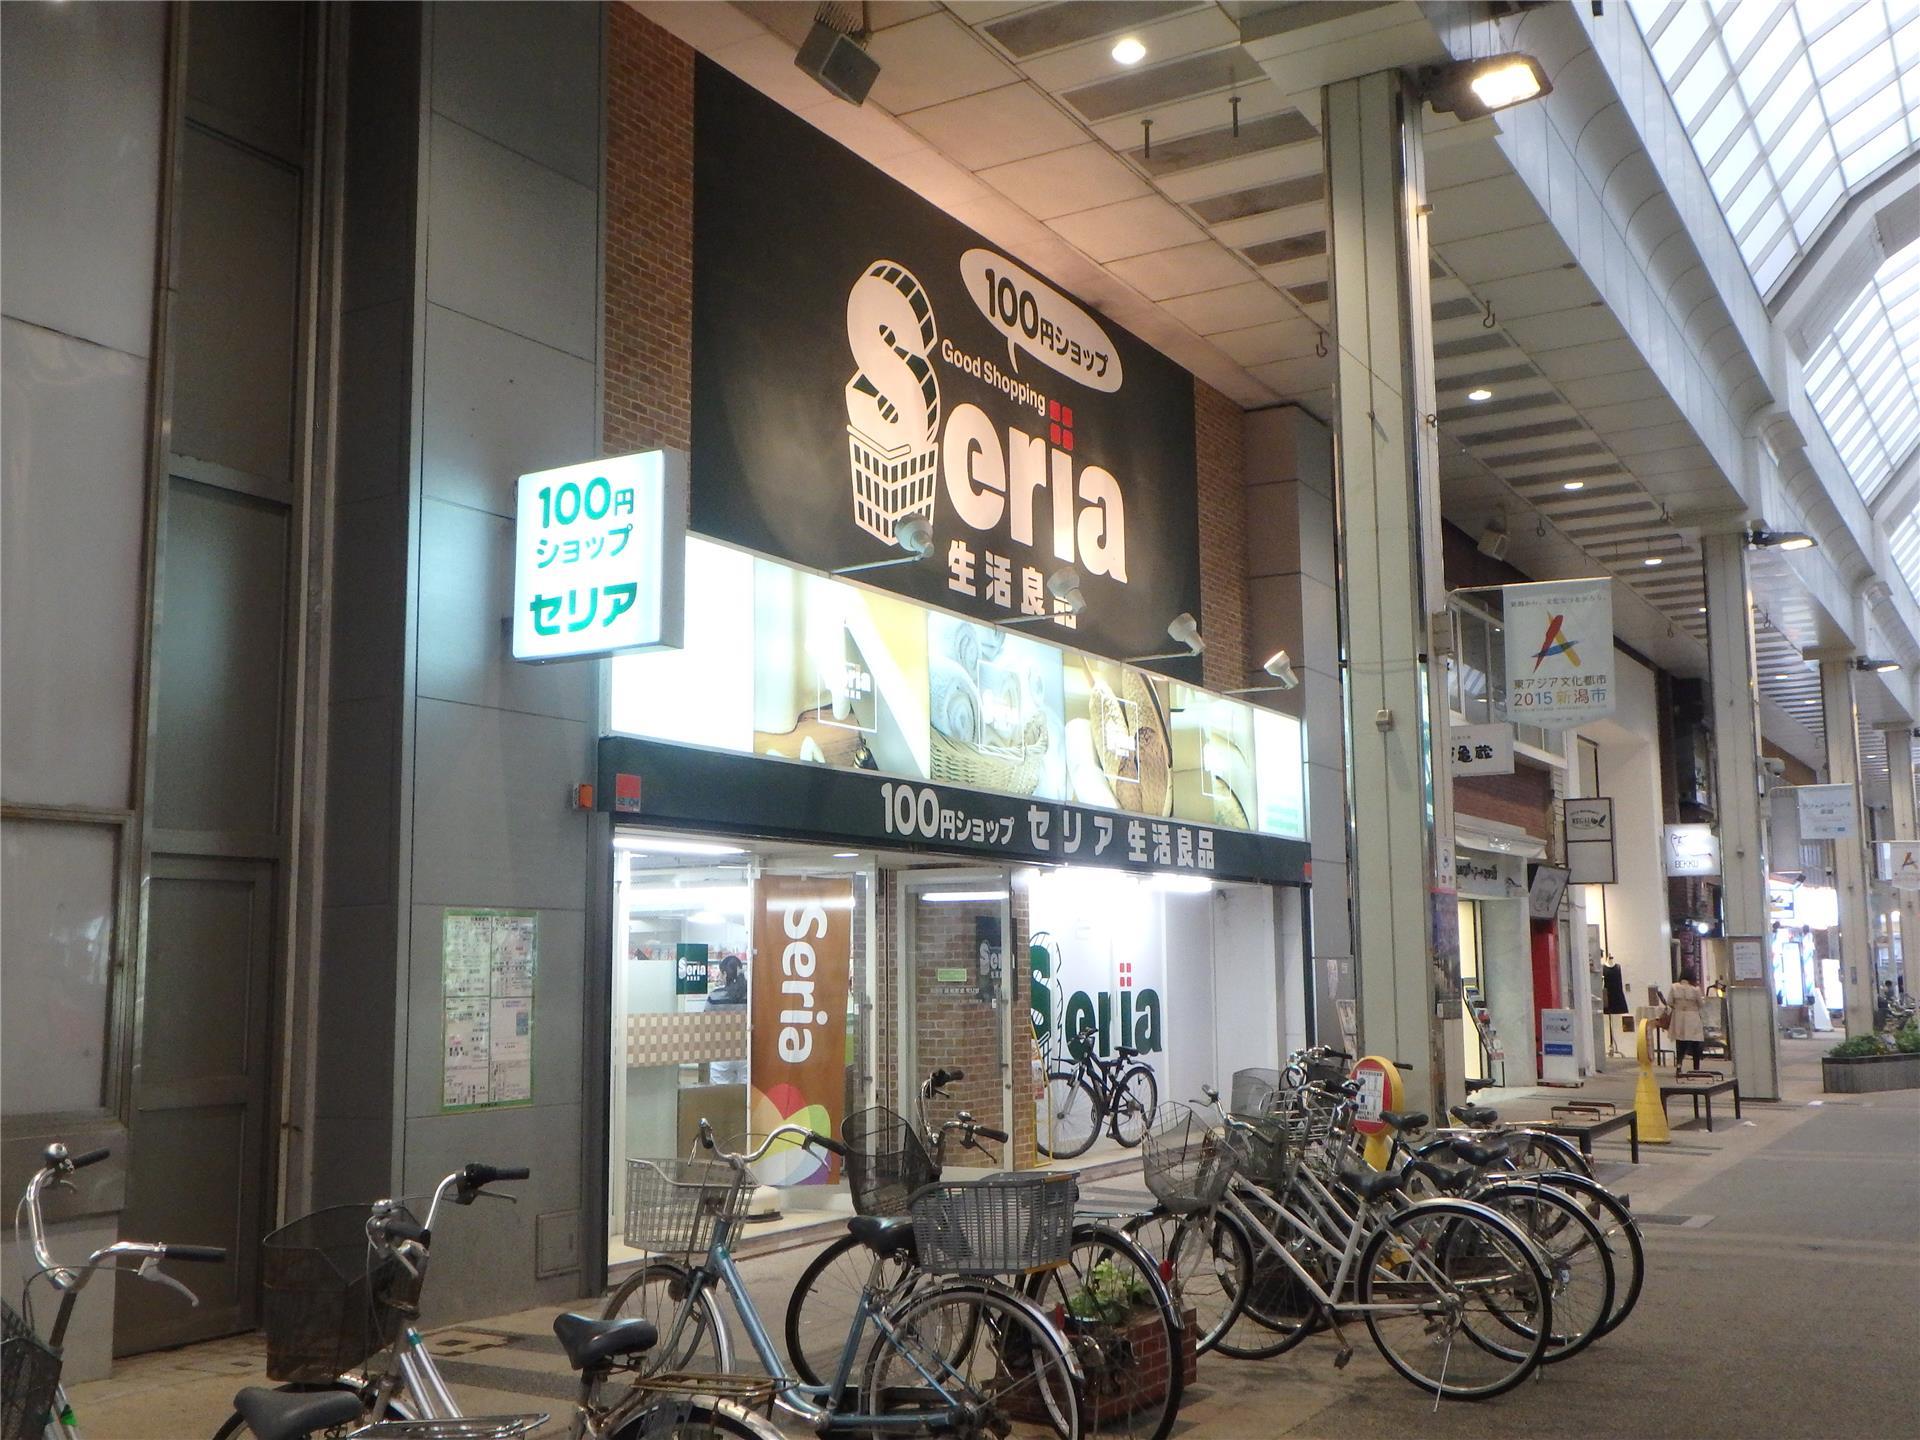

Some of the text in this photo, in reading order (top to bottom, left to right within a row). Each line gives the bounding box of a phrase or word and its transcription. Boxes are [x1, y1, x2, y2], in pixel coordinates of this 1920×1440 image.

[985, 268, 1109, 378] 100円ショップ
[942, 339, 1046, 416] Good Shopping
[846, 259, 1128, 584] Seria
[538, 477, 635, 529] 100円
[537, 523, 634, 569] ショップ
[529, 582, 638, 636] セリア
[1513, 674, 1607, 690] 東アジア文化都市
[1513, 687, 1608, 707] 2015 新潟市
[880, 782, 1216, 870] 100円ショップ セリア 生活良品
[778, 902, 829, 1063] Seria
[1029, 931, 1163, 1068] Seria
